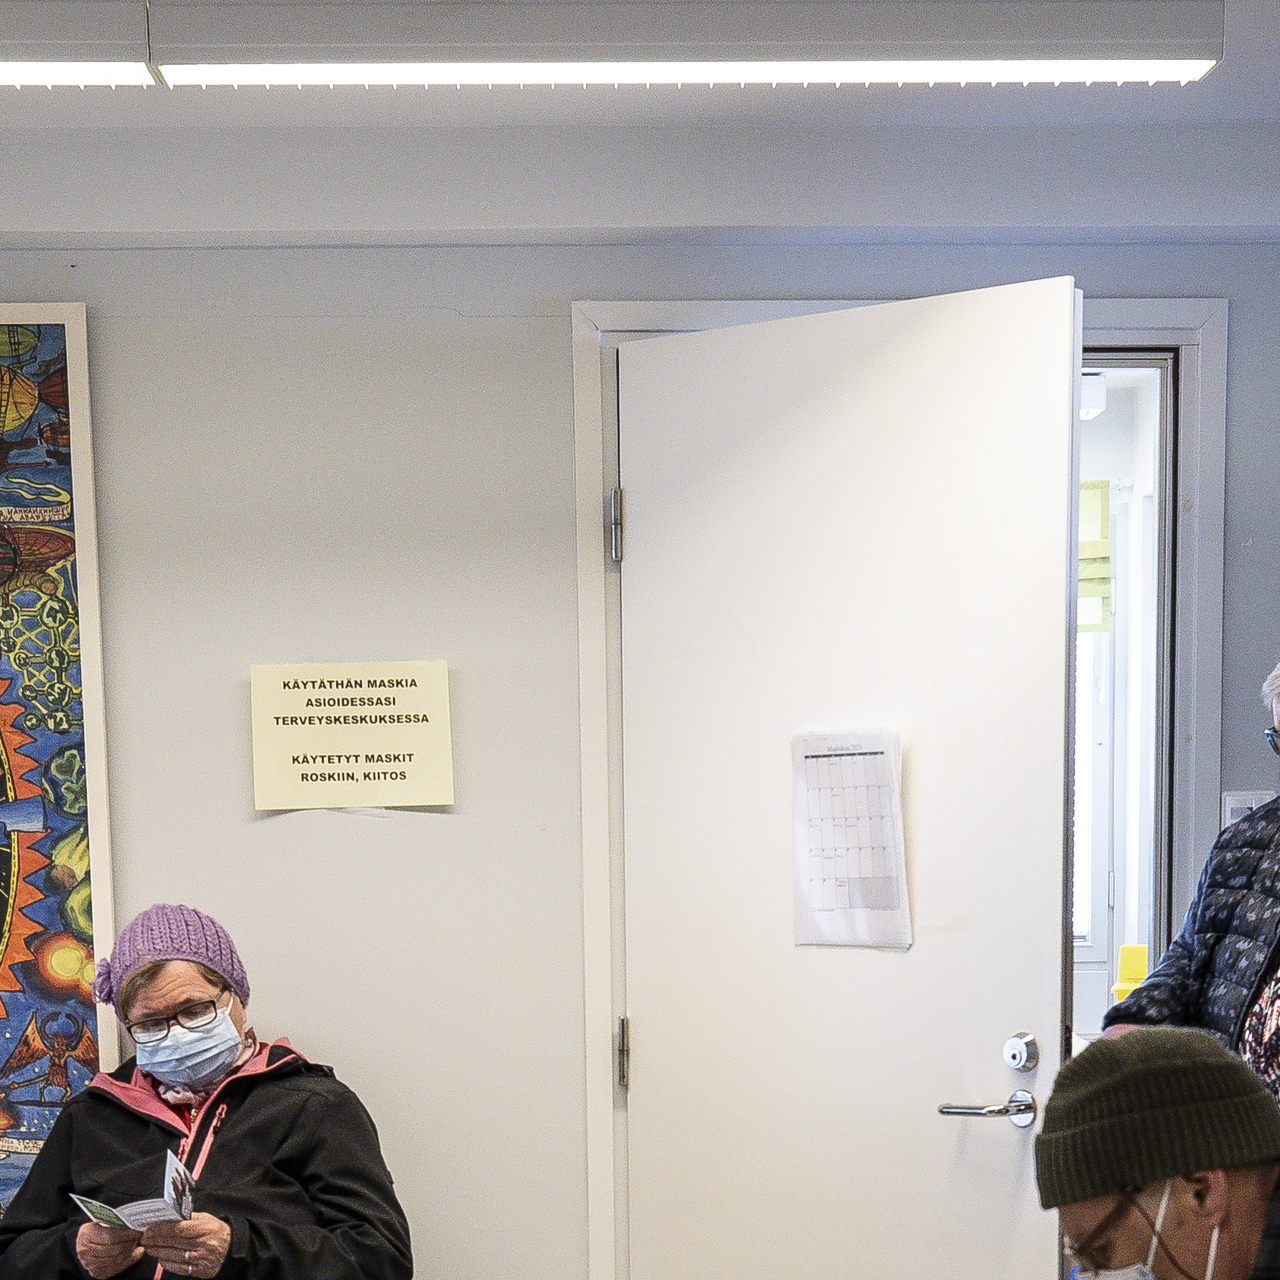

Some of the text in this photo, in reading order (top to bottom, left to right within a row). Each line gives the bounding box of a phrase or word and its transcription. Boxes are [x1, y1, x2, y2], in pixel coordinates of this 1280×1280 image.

[282, 678, 418, 690] KÄYTÄTHÄN MASKIA
[305, 696, 396, 707] ASIOIDESSASI
[273, 713, 430, 726] TERVEYSKESKUKSESSA
[291, 753, 415, 765] KÄYTETYT MASKIT
[300, 770, 407, 783] ROSKIIN, KIITOS
